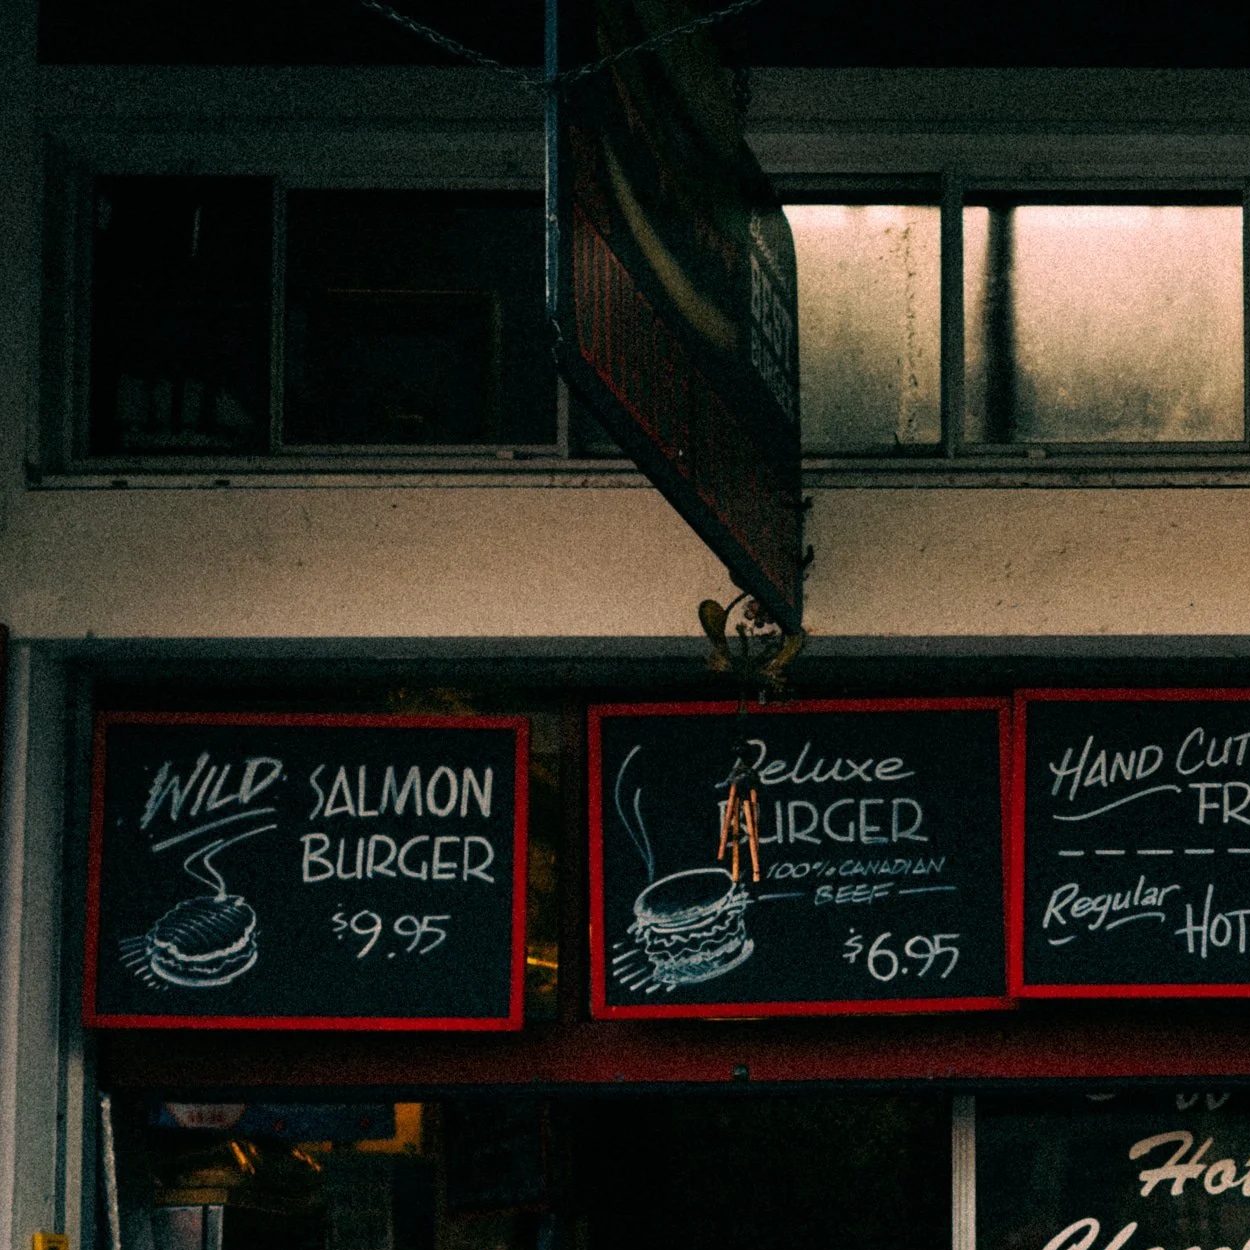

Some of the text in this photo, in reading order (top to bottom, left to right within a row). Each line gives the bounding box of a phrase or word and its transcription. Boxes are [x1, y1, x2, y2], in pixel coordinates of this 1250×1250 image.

[714, 739, 916, 788] Deluxe
[141, 753, 286, 829] WILD
[308, 764, 494, 820] SALMON
[301, 834, 495, 884] BURGER
[766, 857, 945, 879] 100% CANADIAN
[815, 882, 894, 906] BEEF
[1042, 875, 1180, 930] Regular
[332, 904, 451, 959] $9.95
[842, 928, 960, 981] $6.95
